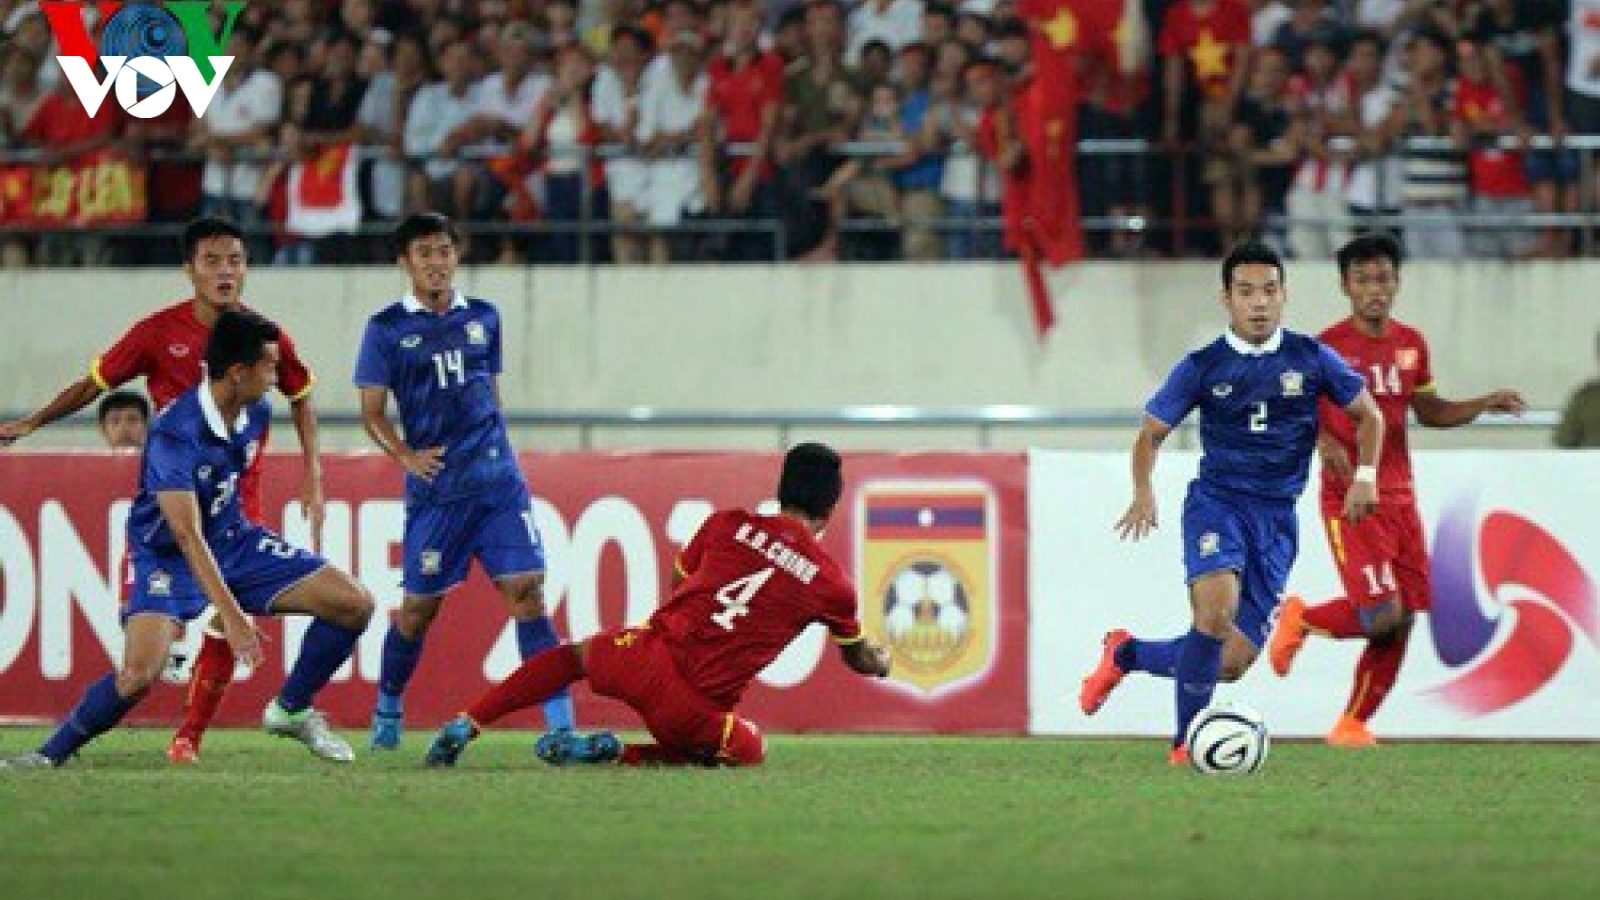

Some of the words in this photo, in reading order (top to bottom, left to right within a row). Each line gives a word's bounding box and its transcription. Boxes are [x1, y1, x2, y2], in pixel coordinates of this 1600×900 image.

[432, 350, 465, 389] 14
[1369, 365, 1401, 394] 14
[1249, 400, 1268, 432] 2
[1361, 560, 1397, 595] 14
[710, 567, 775, 631] 4
